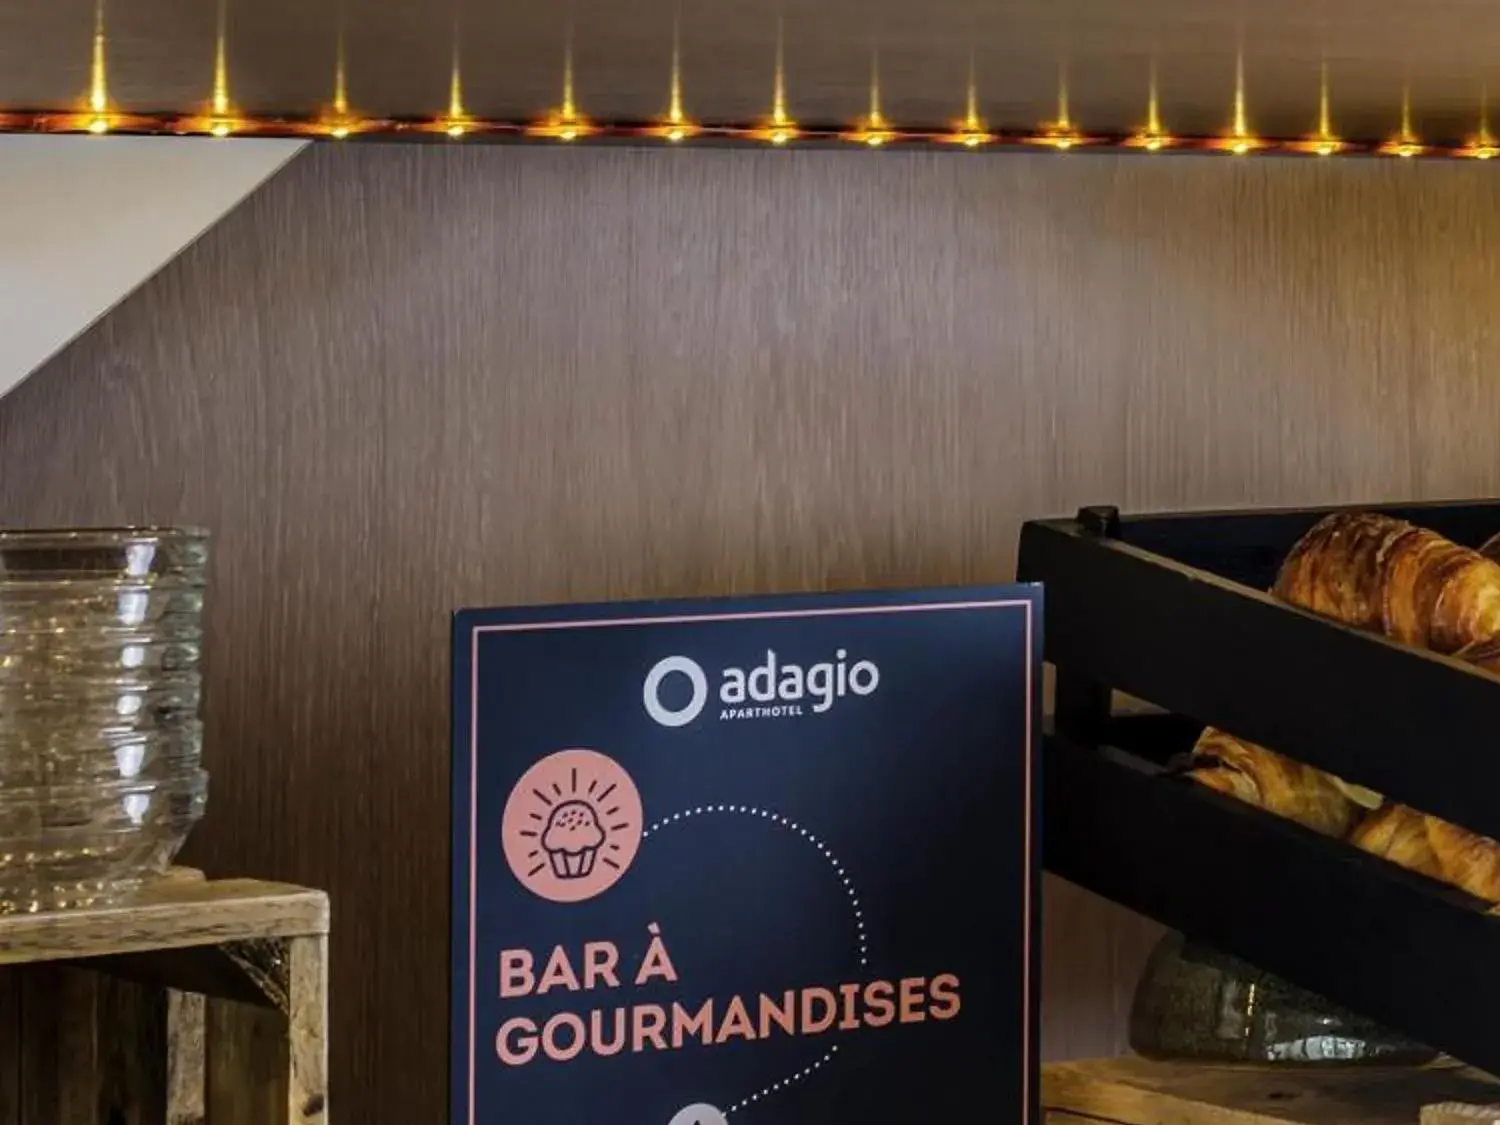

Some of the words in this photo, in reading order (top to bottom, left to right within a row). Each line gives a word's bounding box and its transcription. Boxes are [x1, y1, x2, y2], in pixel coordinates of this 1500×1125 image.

[719, 705, 804, 719] APARTHOTEL
[720, 649, 880, 713] adagio
[499, 942, 620, 998] BAR
[634, 923, 678, 984] À
[495, 974, 962, 1066] GOURMANDISES
